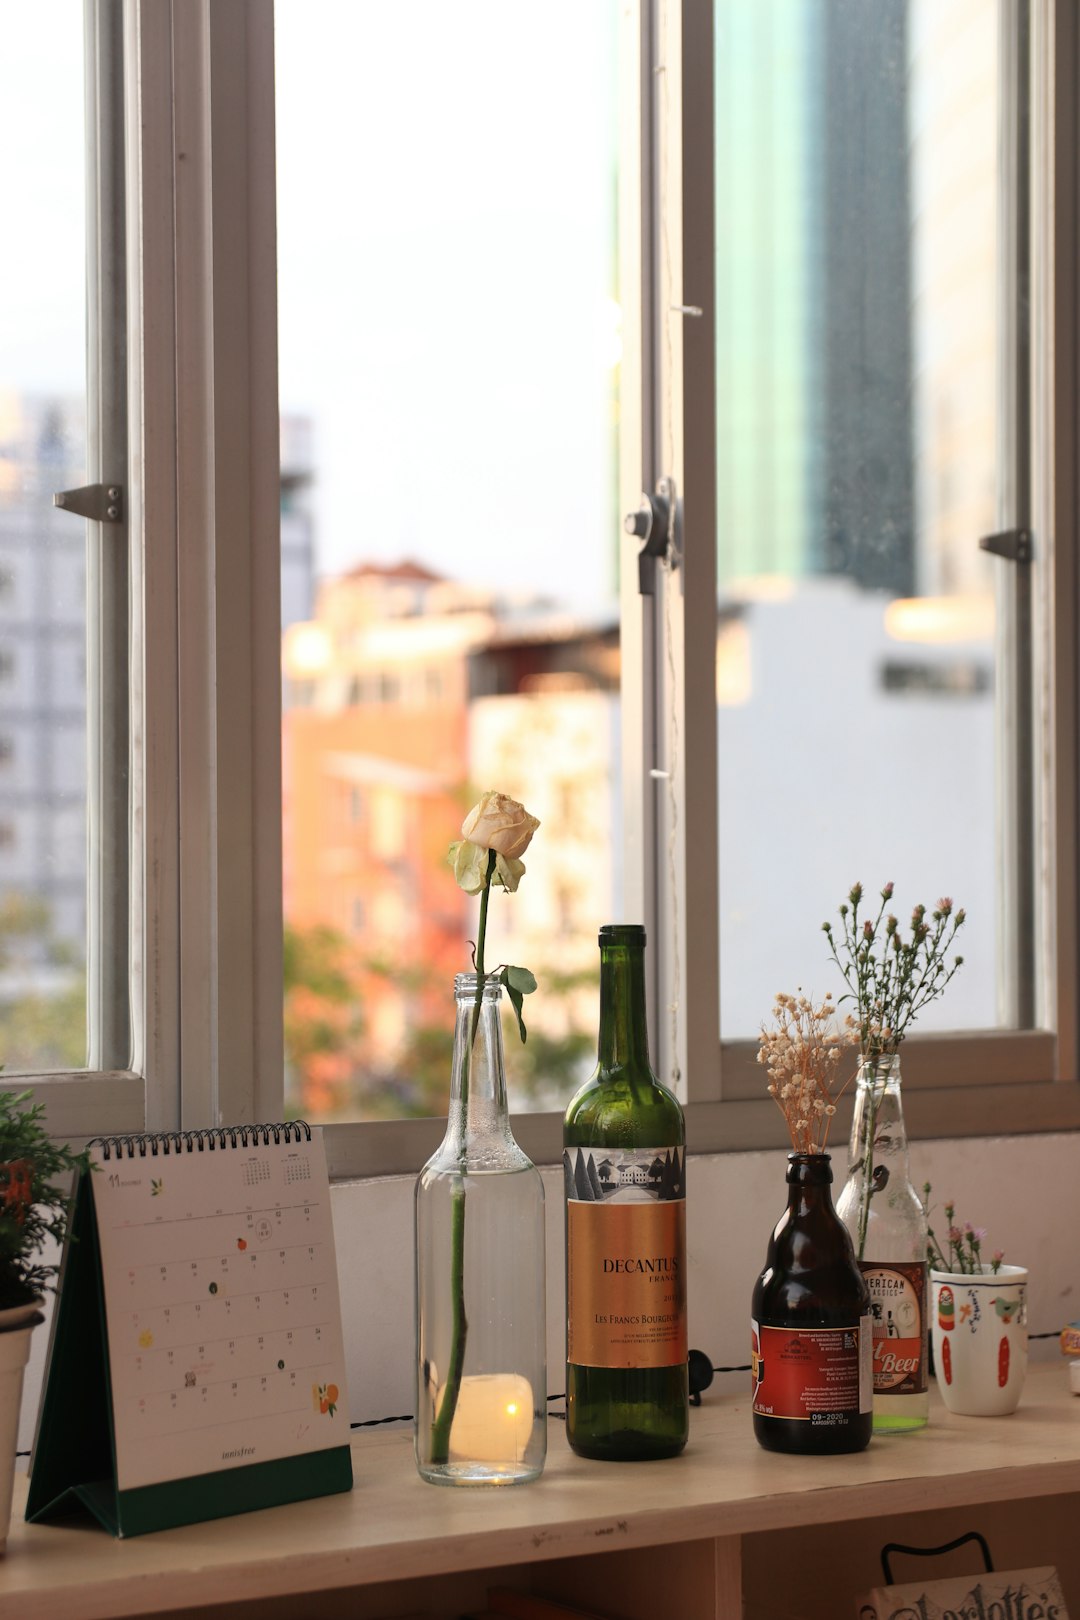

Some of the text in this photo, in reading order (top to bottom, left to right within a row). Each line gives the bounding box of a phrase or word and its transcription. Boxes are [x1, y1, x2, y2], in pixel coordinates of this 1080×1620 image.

[109, 1174, 120, 1187] 11
[603, 1257, 678, 1273] DECANTUS
[863, 1278, 905, 1289] MERICAN
[595, 1313, 608, 1324] LES
[609, 1314, 640, 1325] FRANCS
[881, 1352, 920, 1373] Beer
[222, 1446, 256, 1460] innisfree
